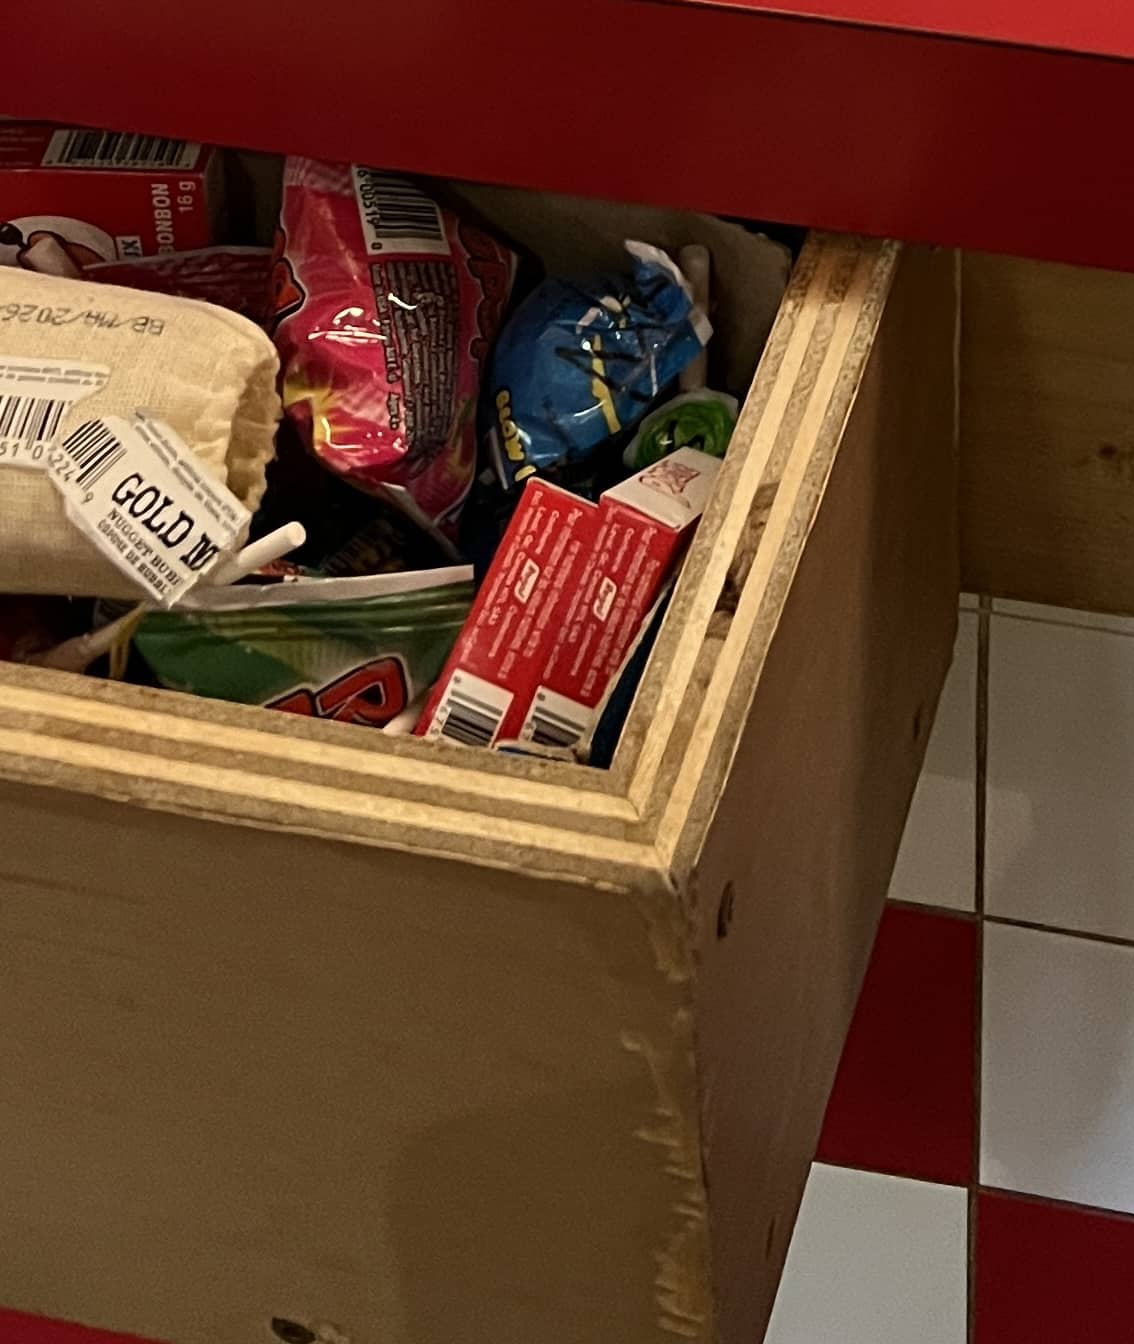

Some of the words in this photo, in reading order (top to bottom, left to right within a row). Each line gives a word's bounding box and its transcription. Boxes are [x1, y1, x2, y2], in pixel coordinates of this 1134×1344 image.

[177, 195, 194, 214] 16
[107, 507, 154, 558] NUGGET
[111, 472, 196, 549] GOLD
